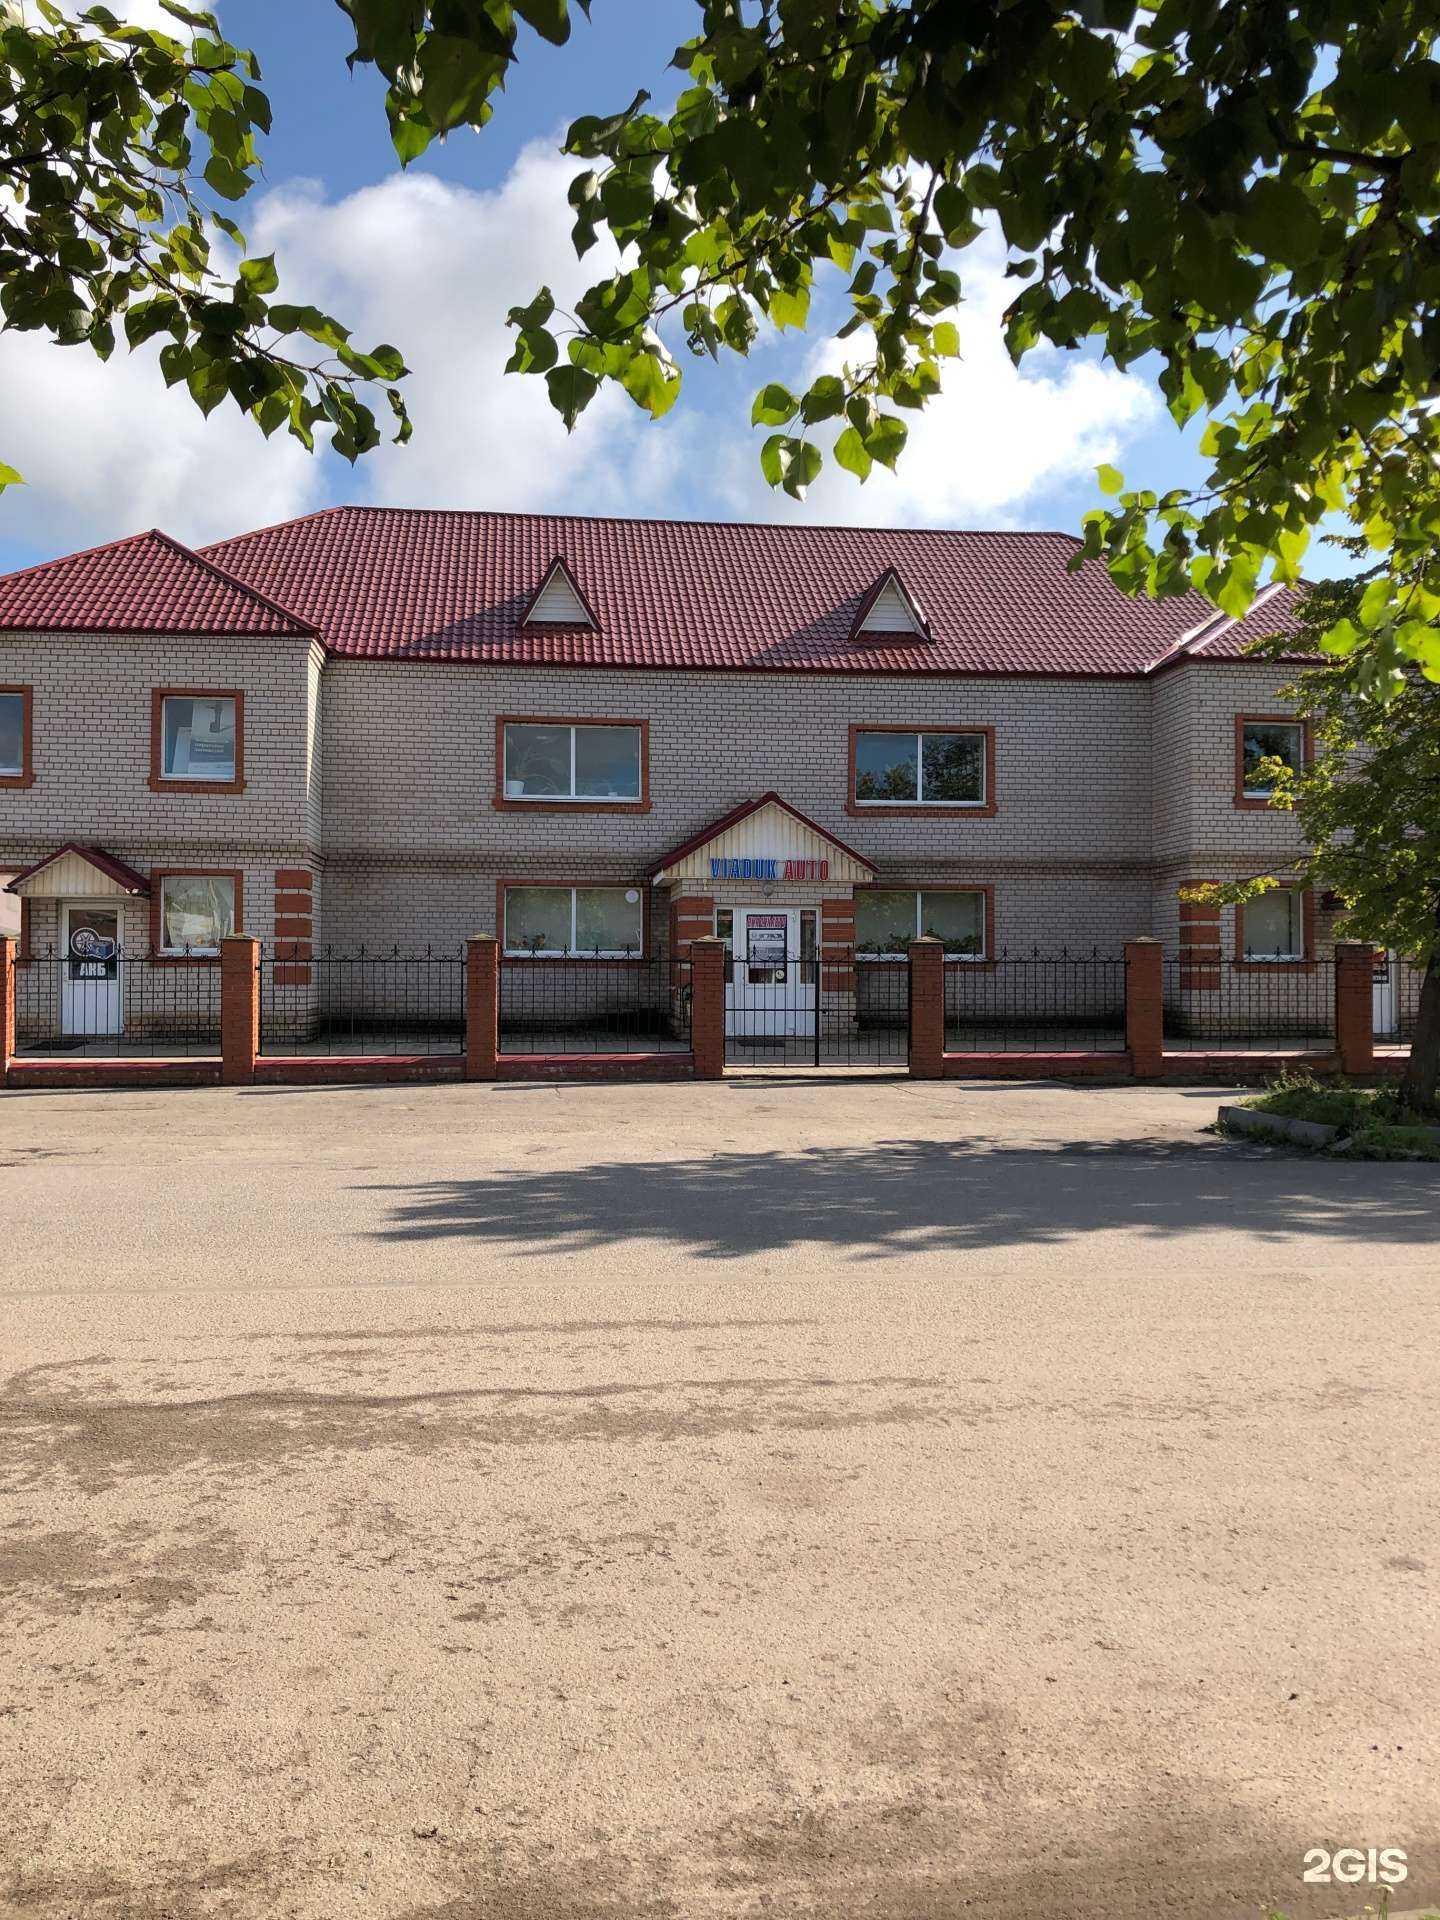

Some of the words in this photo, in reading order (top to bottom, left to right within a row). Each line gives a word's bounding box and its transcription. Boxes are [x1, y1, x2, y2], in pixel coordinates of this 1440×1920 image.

[711, 858, 776, 880] VIADUK
[784, 859, 829, 880] AUTO
[80, 962, 106, 977] АКБ
